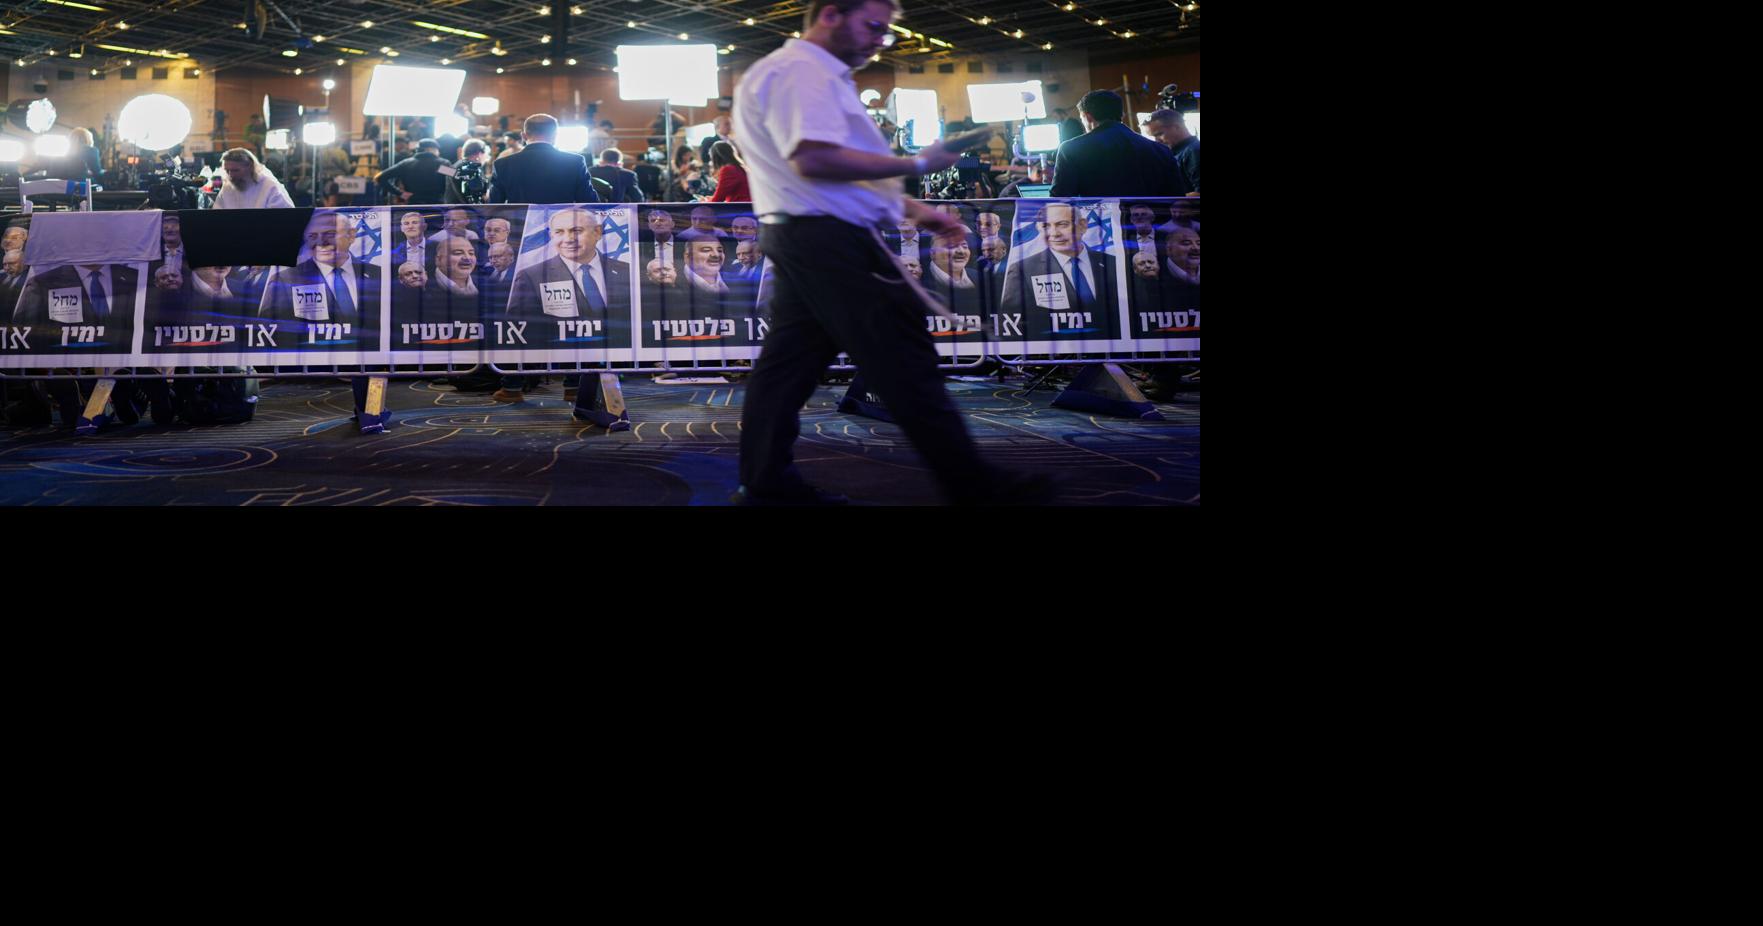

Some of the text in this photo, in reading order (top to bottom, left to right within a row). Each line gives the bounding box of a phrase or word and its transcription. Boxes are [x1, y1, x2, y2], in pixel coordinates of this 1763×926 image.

[296, 288, 322, 304] מחל
[544, 285, 571, 300] מחל
[1036, 278, 1062, 294] מחל
[52, 291, 78, 306] מחל
[401, 320, 601, 344] ימין או פלסטין
[652, 316, 735, 340] פלסטין
[990, 313, 1023, 336] או
[1050, 312, 1092, 333] ימין
[1139, 309, 1200, 332] לסטין
[0, 326, 104, 349] ימין או
[154, 323, 351, 347] ימין או פלסטין
